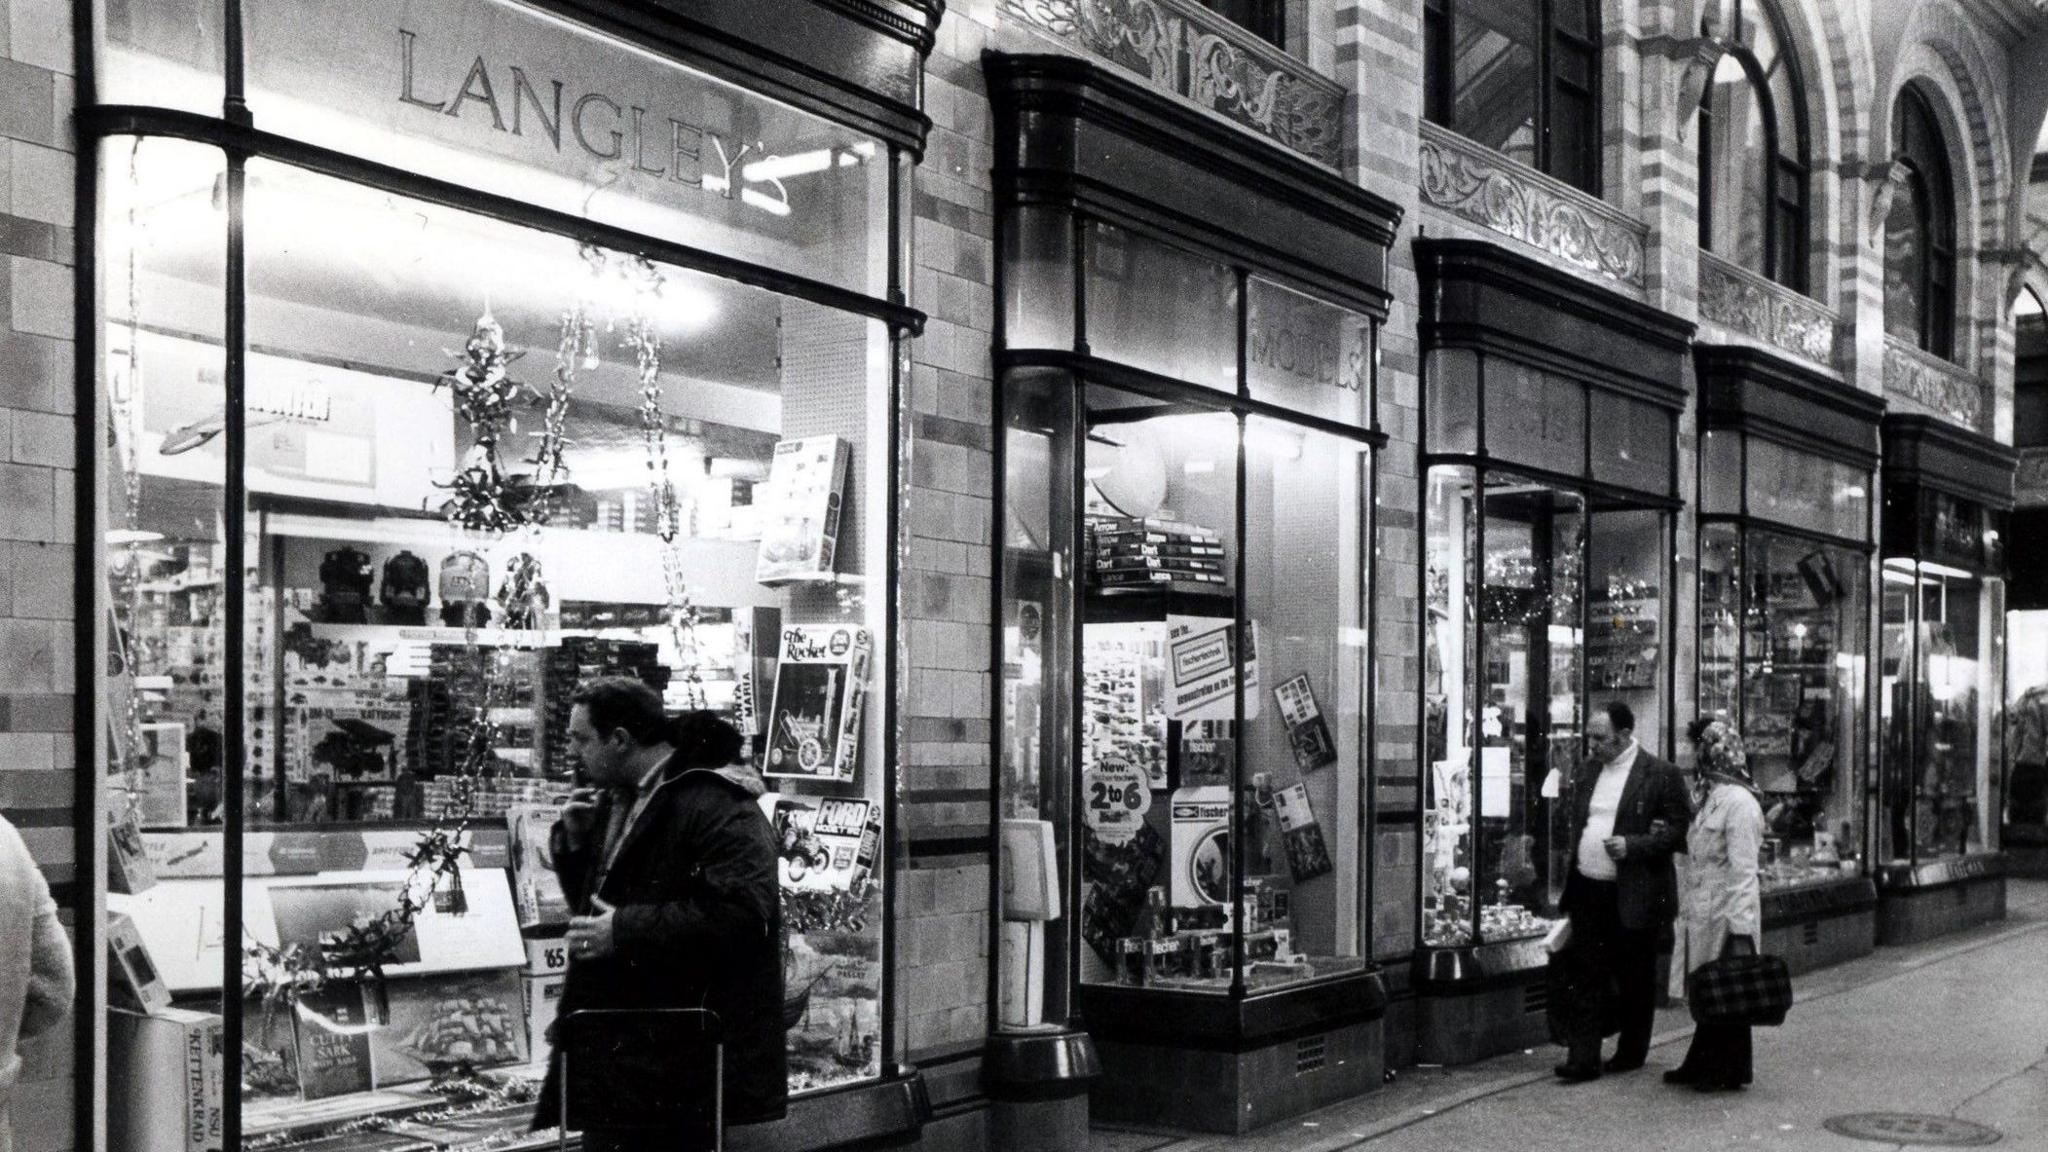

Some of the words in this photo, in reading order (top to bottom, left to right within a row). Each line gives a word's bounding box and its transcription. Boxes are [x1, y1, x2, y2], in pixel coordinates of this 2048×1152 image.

[1251, 326, 1361, 392] MODELS
[783, 627, 807, 645] The
[787, 639, 827, 661] Rocket
[735, 684, 745, 733] SANTA
[743, 672, 753, 718] MARIA
[1100, 761, 1129, 773] New:
[1090, 782, 1111, 809] 2
[1108, 785, 1122, 803] to
[1124, 783, 1142, 810] 6
[821, 801, 867, 827] FORD
[1200, 806, 1229, 818] fischer
[544, 948, 565, 969] '65
[189, 1029, 204, 1143] KETTENKRAD
[208, 1106, 221, 1138] NSU
